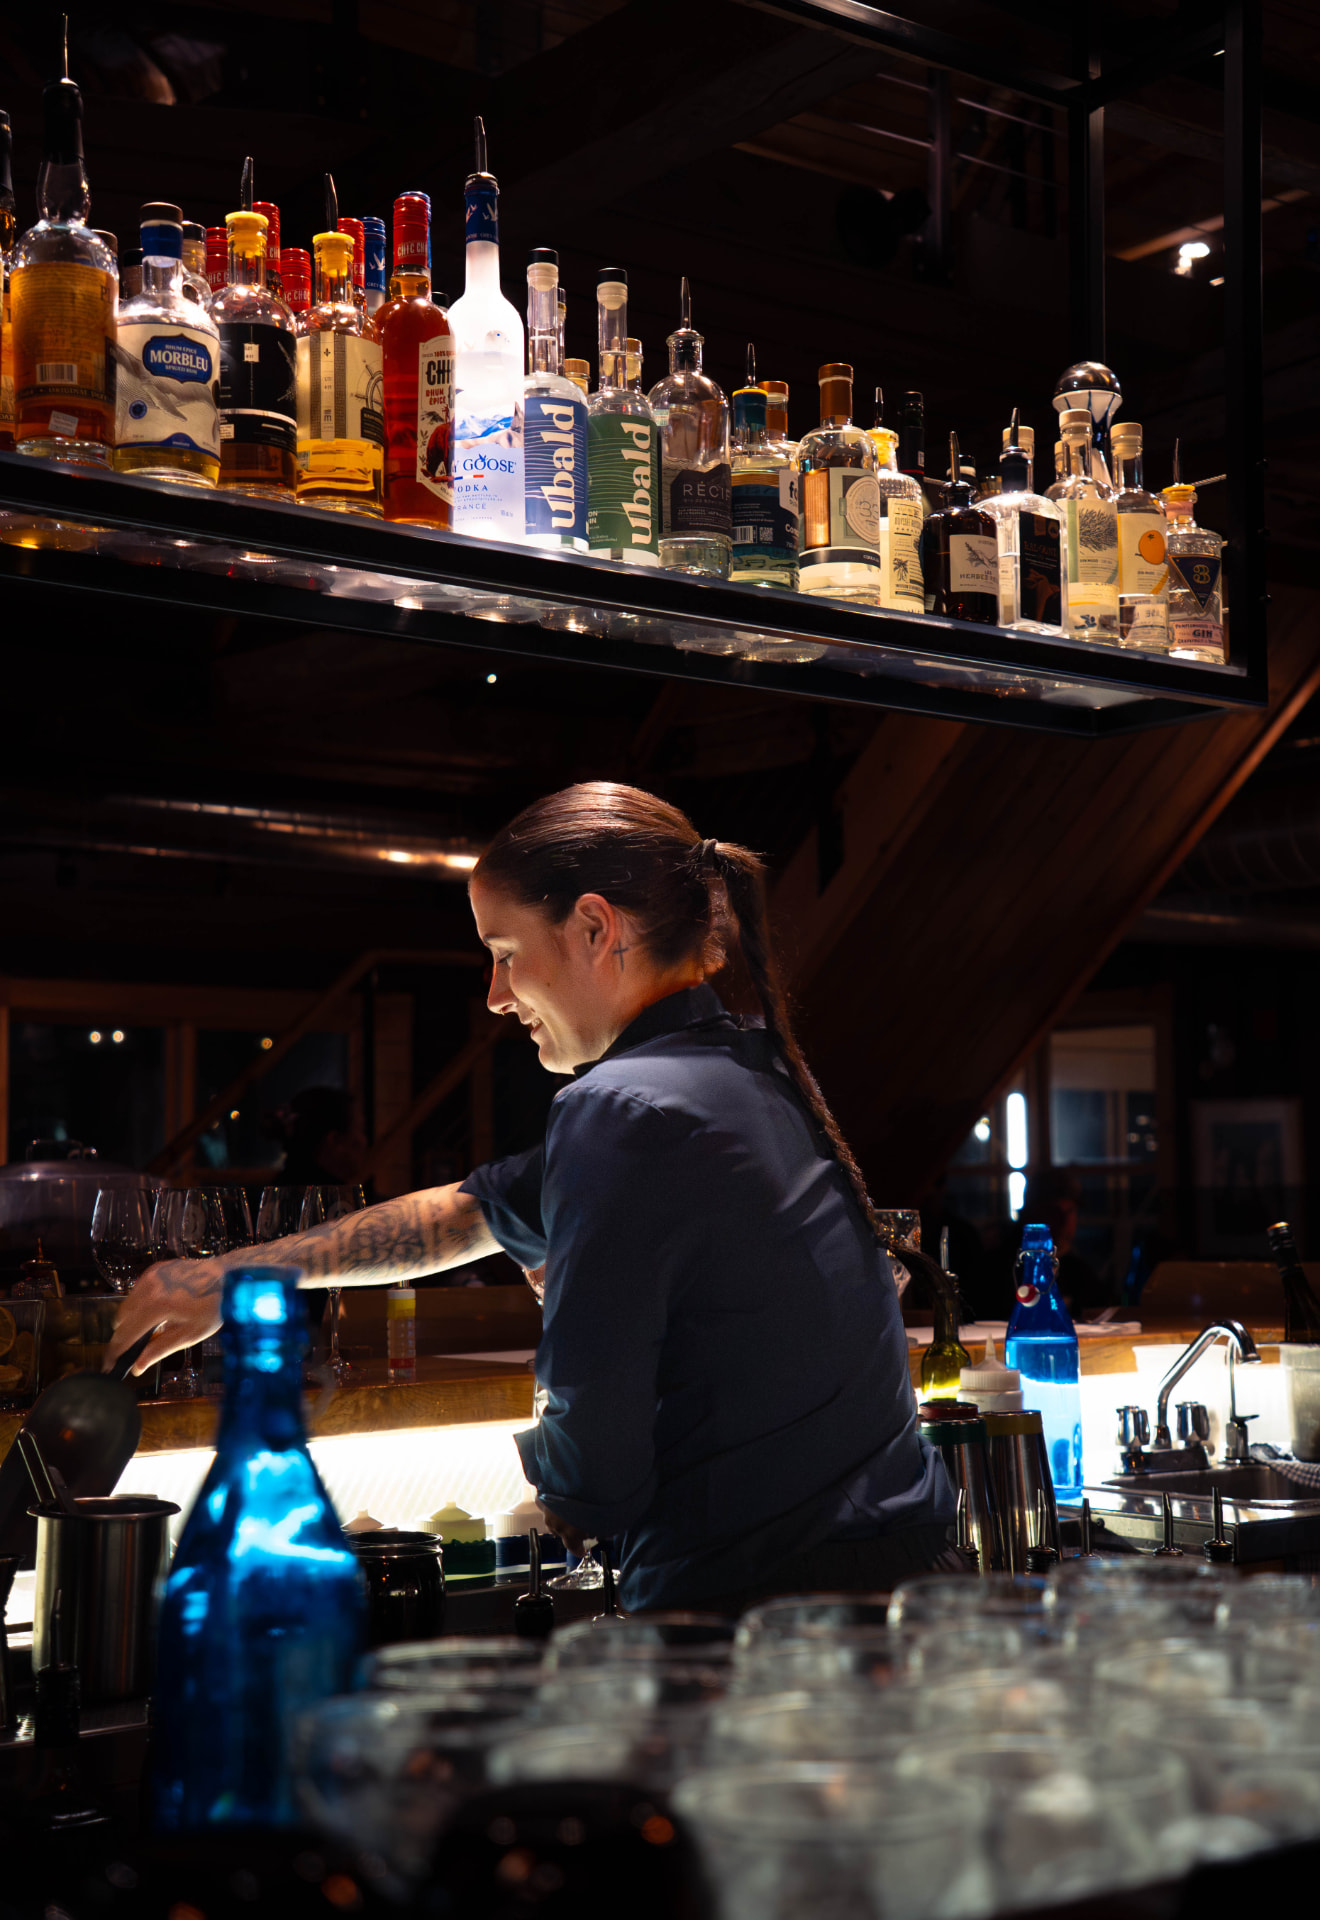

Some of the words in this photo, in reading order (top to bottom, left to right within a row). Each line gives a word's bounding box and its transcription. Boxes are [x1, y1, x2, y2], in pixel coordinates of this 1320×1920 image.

[398, 242, 415, 258] CHIC
[150, 350, 208, 372] MORBLEU
[463, 457, 514, 474] GOOSE
[540, 404, 575, 528] ubald
[455, 484, 488, 493] ODKA
[620, 422, 652, 544] ubald
[1193, 564, 1210, 584] 3
[1192, 629, 1212, 638] GIN
